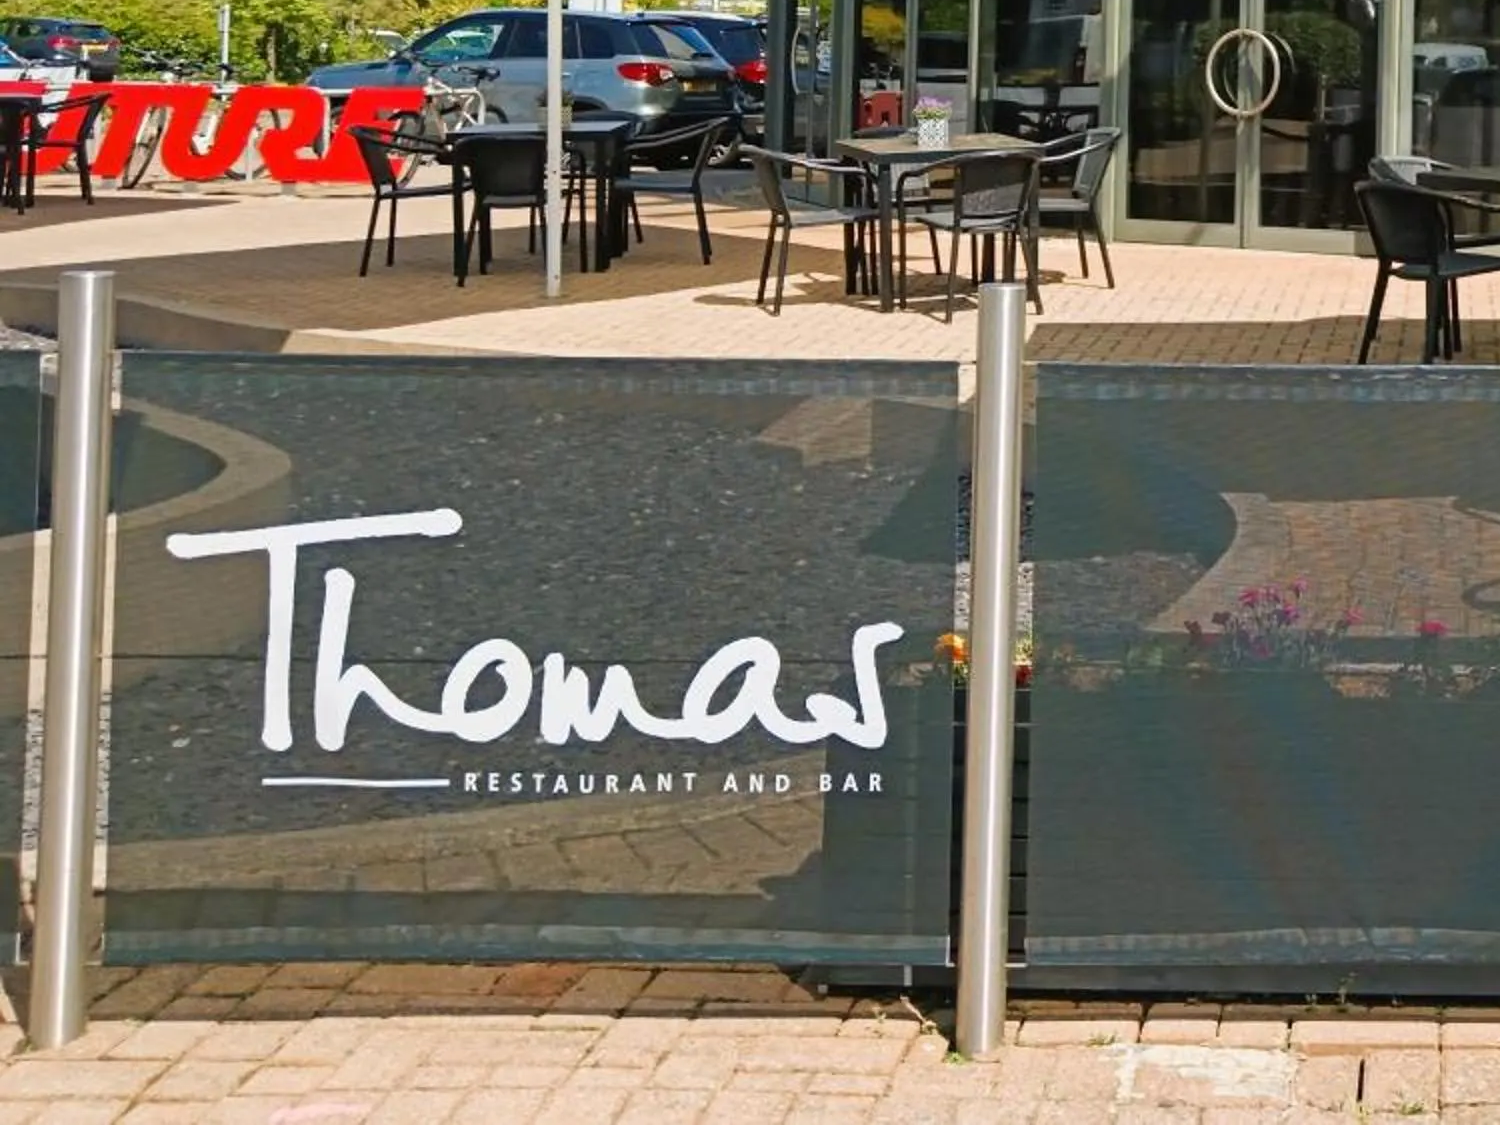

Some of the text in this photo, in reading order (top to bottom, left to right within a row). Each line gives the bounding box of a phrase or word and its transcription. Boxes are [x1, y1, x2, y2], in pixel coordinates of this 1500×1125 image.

[166, 507, 905, 752] Thomas
[464, 771, 883, 795] RESTAURANT AND BAR
